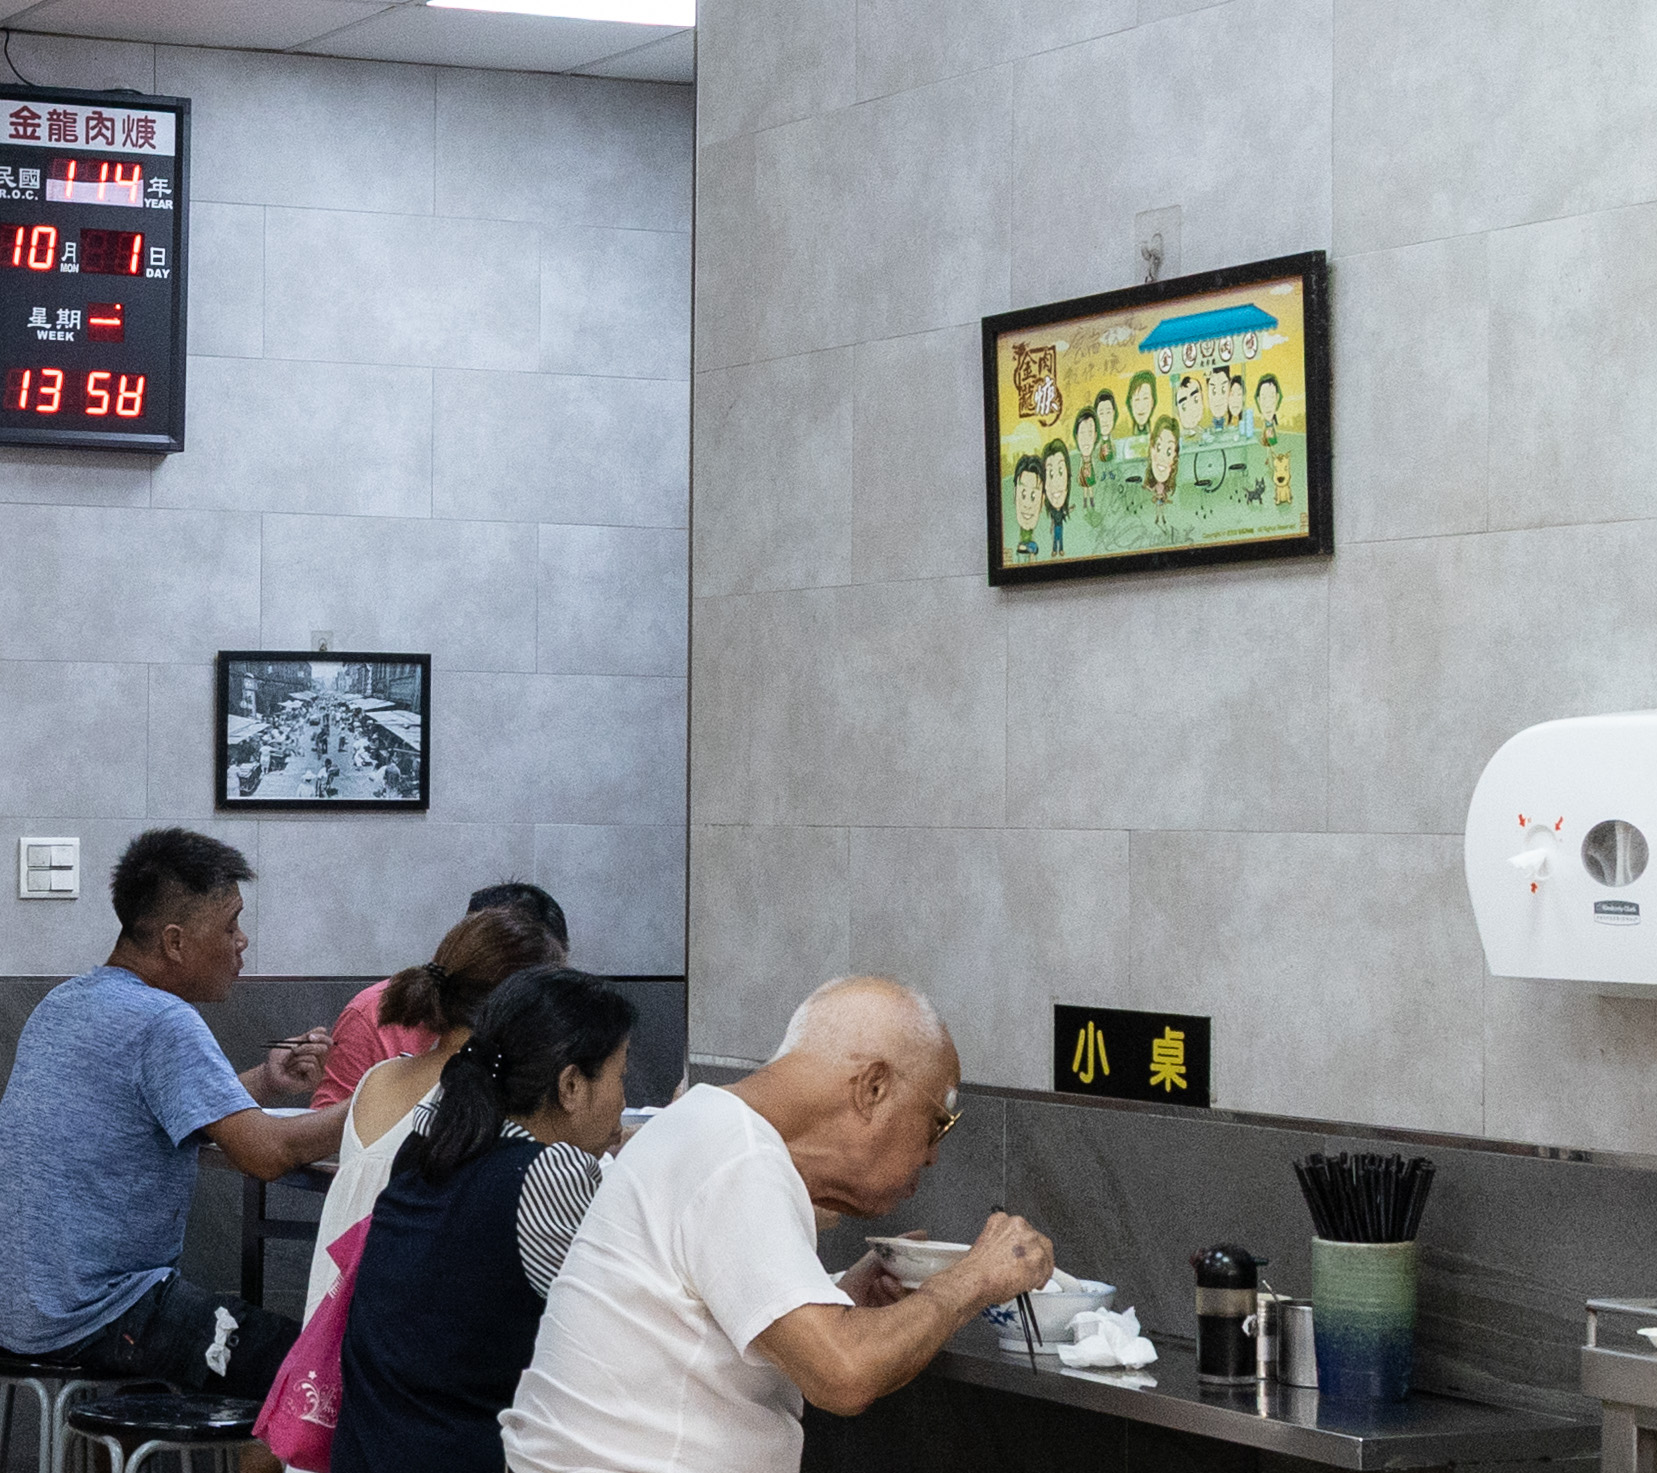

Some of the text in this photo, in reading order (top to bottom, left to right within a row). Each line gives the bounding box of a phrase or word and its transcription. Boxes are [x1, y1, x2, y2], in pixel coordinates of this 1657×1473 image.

[8, 105, 158, 150] 金龍肉焿
[147, 176, 173, 198] 年
[144, 197, 174, 210] YEAR
[13, 225, 167, 274] 10 月 1 日
[59, 262, 171, 279] MON DAY
[27, 306, 82, 331] 星期
[36, 330, 75, 342] WEEK
[1072, 1020, 1188, 1093] 小桌
